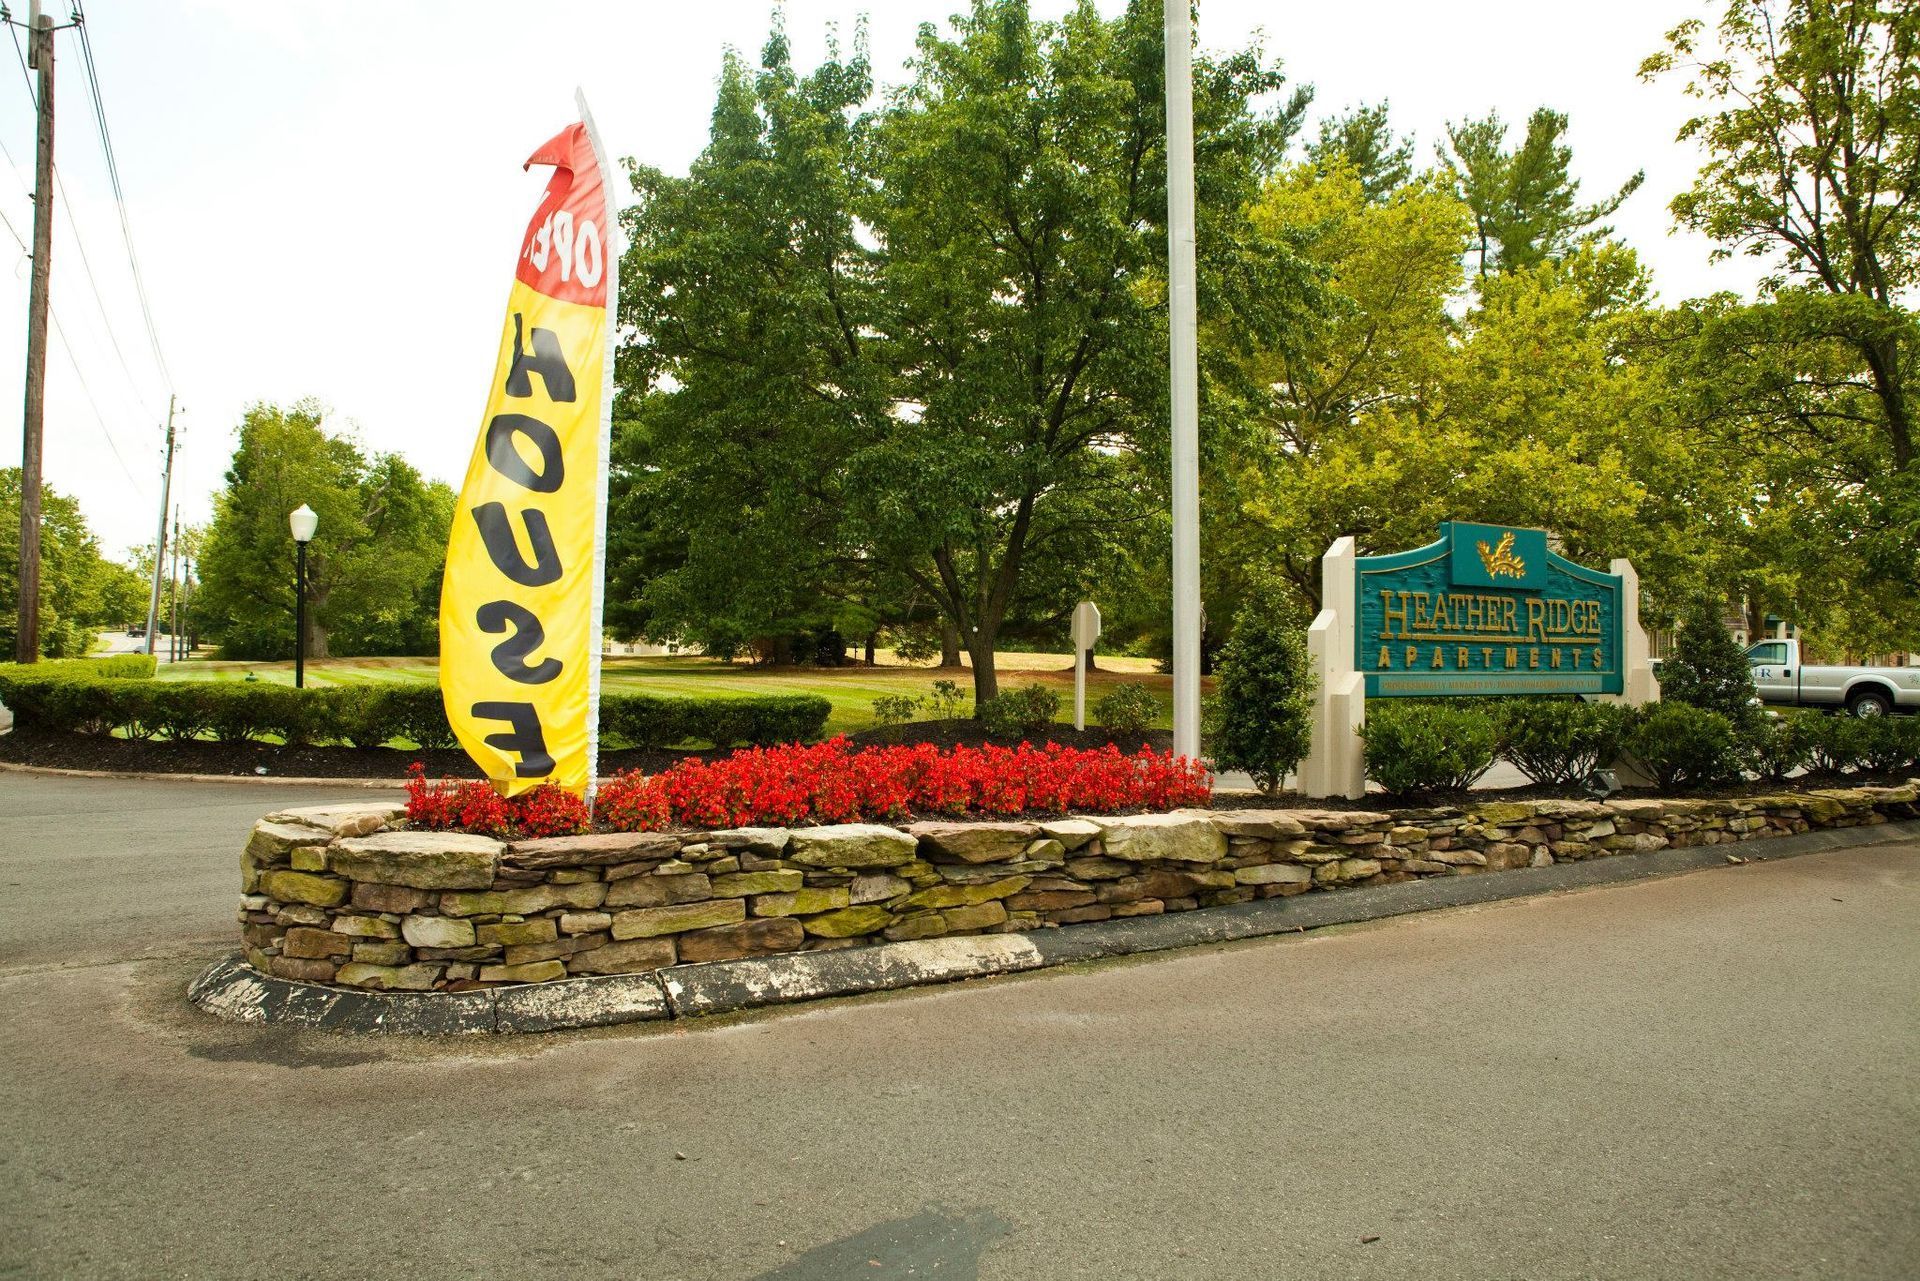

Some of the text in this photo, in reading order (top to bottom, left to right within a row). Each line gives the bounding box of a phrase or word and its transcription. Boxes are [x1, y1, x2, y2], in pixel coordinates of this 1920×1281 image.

[1380, 589, 1601, 643] HEATHER RIDGE
[1377, 645, 1602, 669] APARTMENTS
